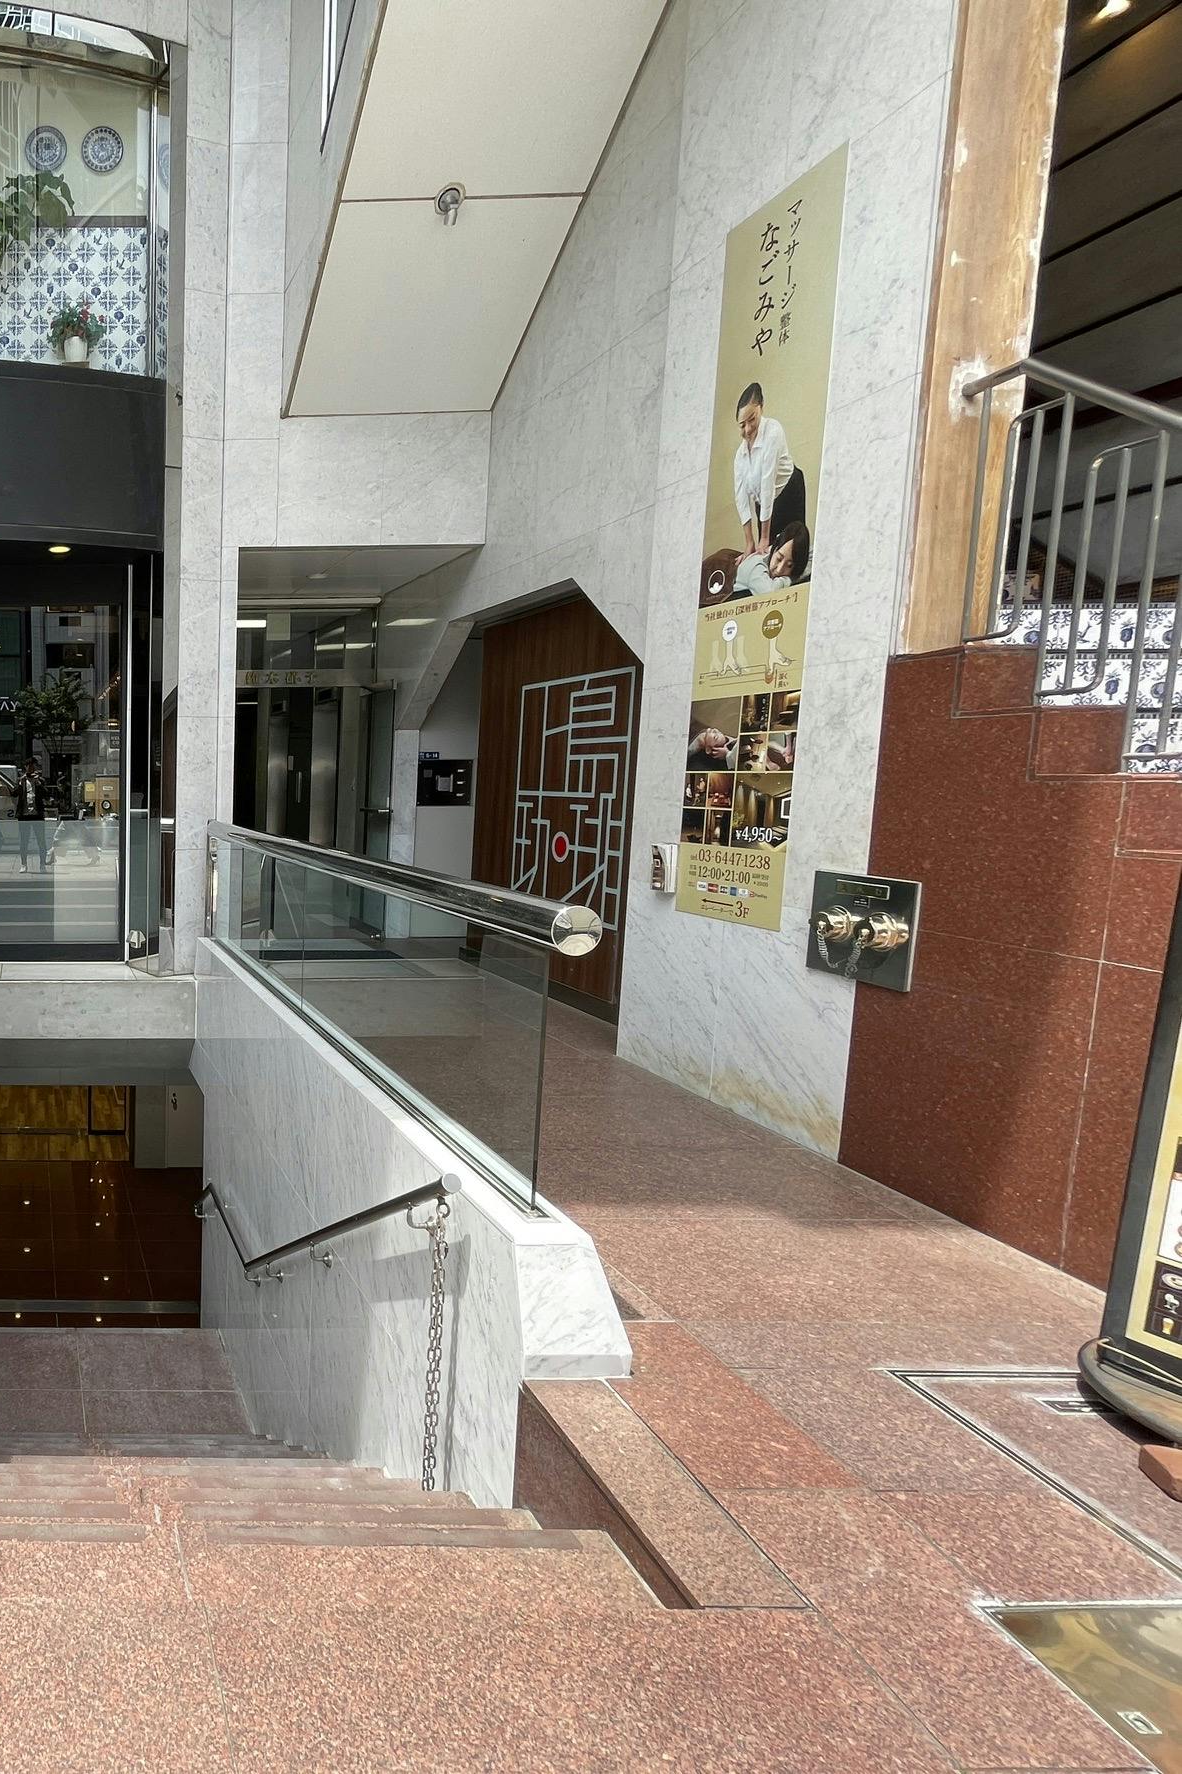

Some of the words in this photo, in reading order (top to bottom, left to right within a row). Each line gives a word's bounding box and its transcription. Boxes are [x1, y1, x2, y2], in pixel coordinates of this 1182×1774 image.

[751, 222, 780, 356] なごみや
[698, 848, 771, 870] 03-6447-1238
[735, 900, 750, 918] 3F
